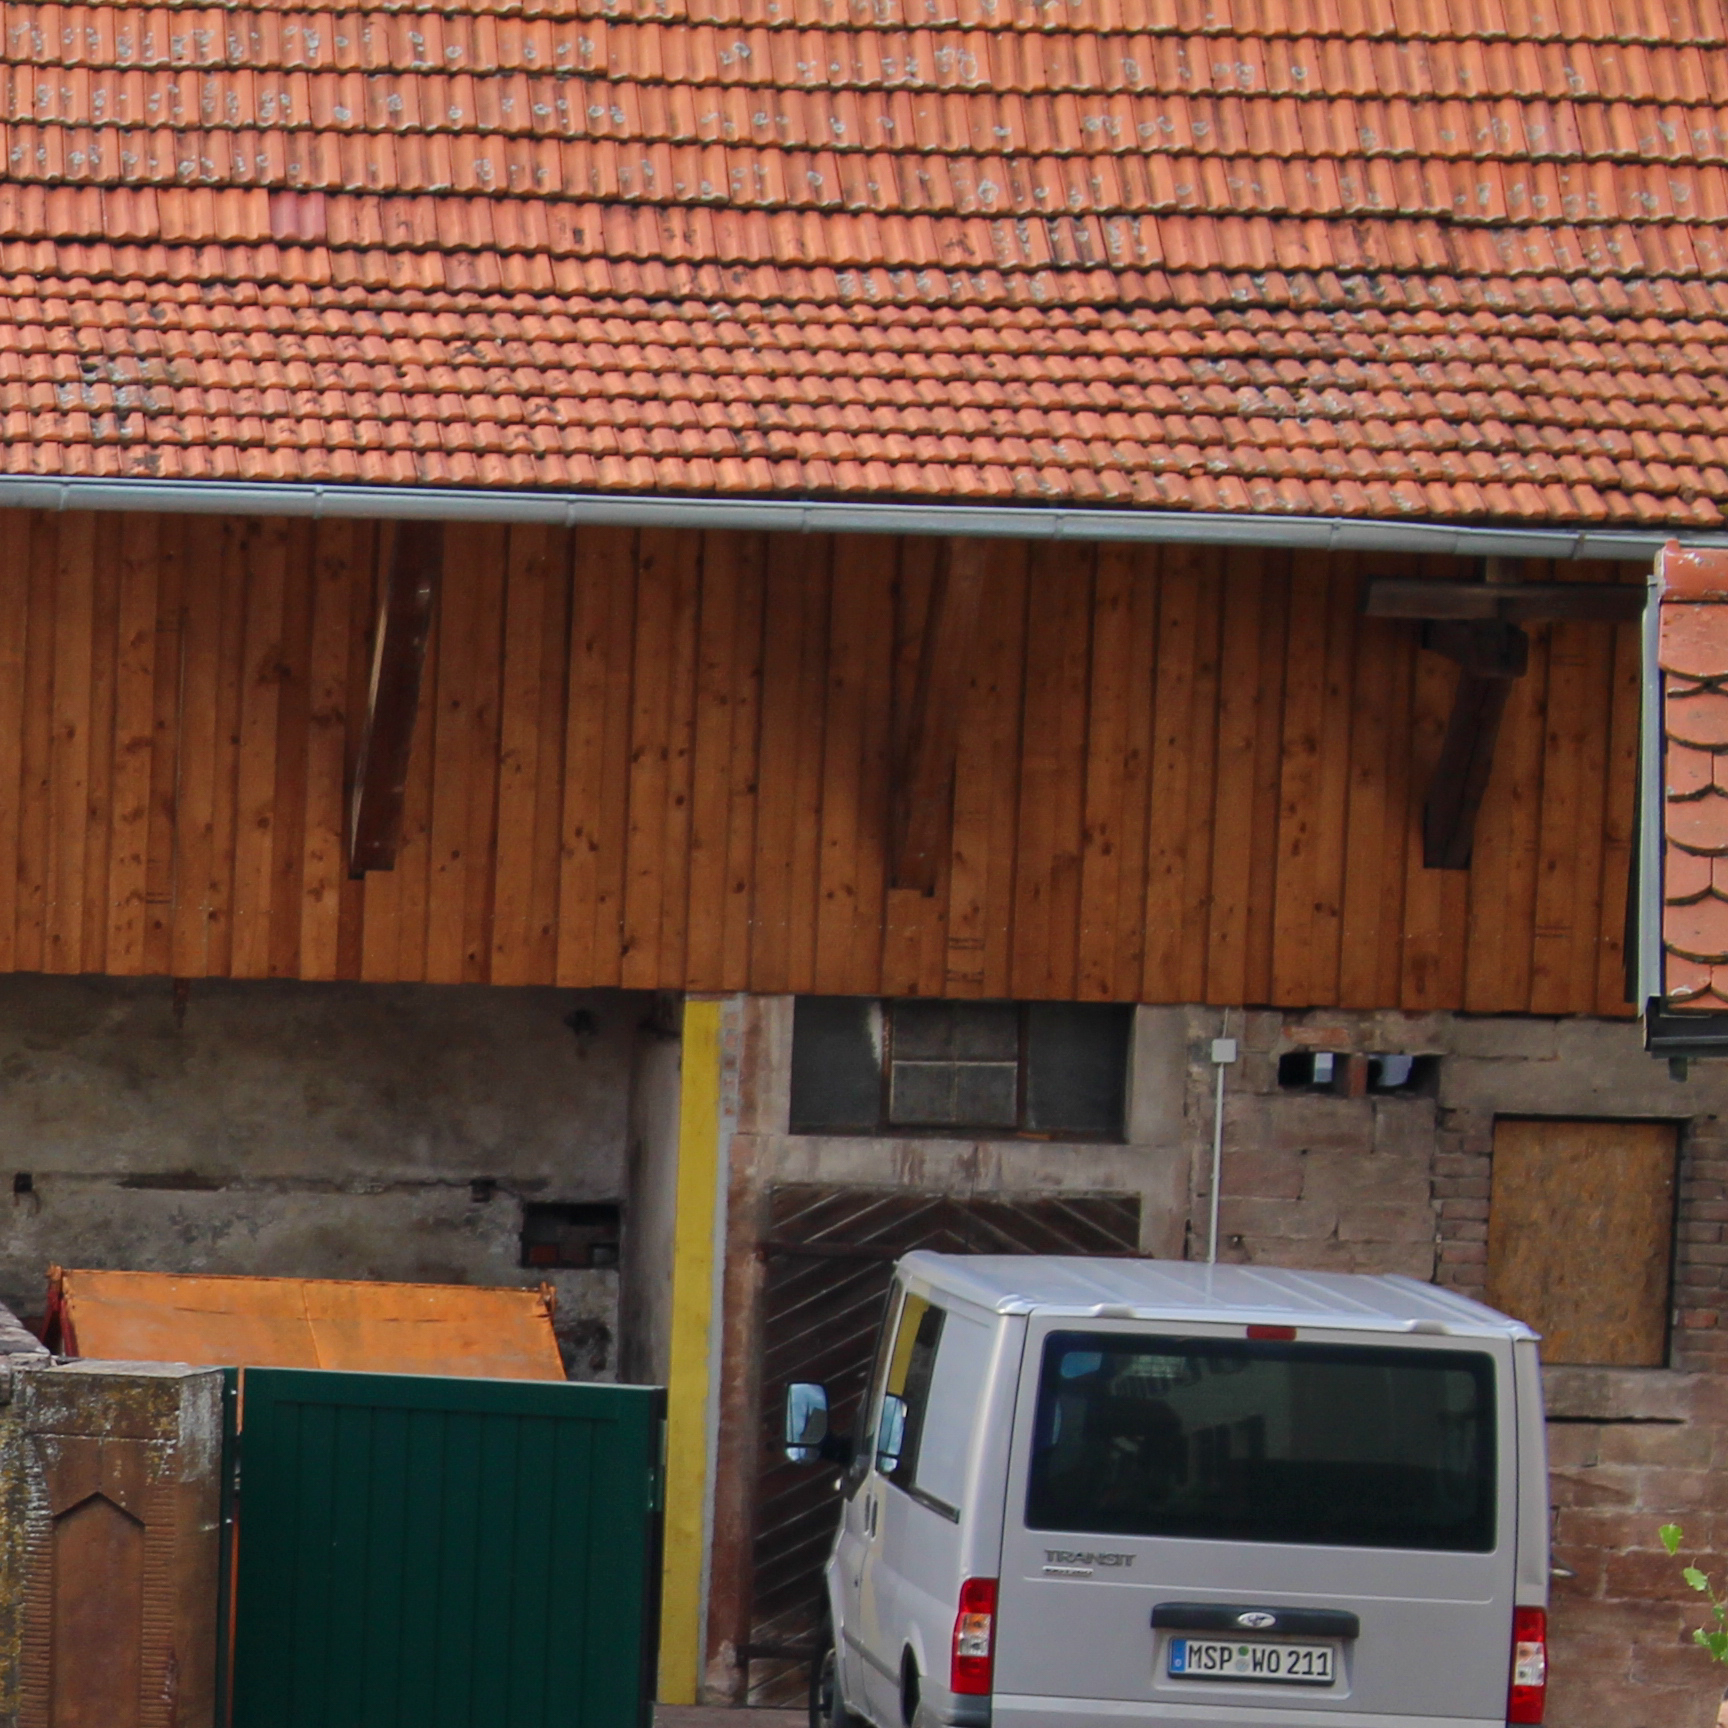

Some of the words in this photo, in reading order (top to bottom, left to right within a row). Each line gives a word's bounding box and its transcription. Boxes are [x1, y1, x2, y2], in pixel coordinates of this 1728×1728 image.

[1044, 1549, 1137, 1566] TRANSIT
[1188, 1644, 1232, 1671] MSP
[1252, 1648, 1281, 1674] WO
[1287, 1650, 1329, 1677] 211
